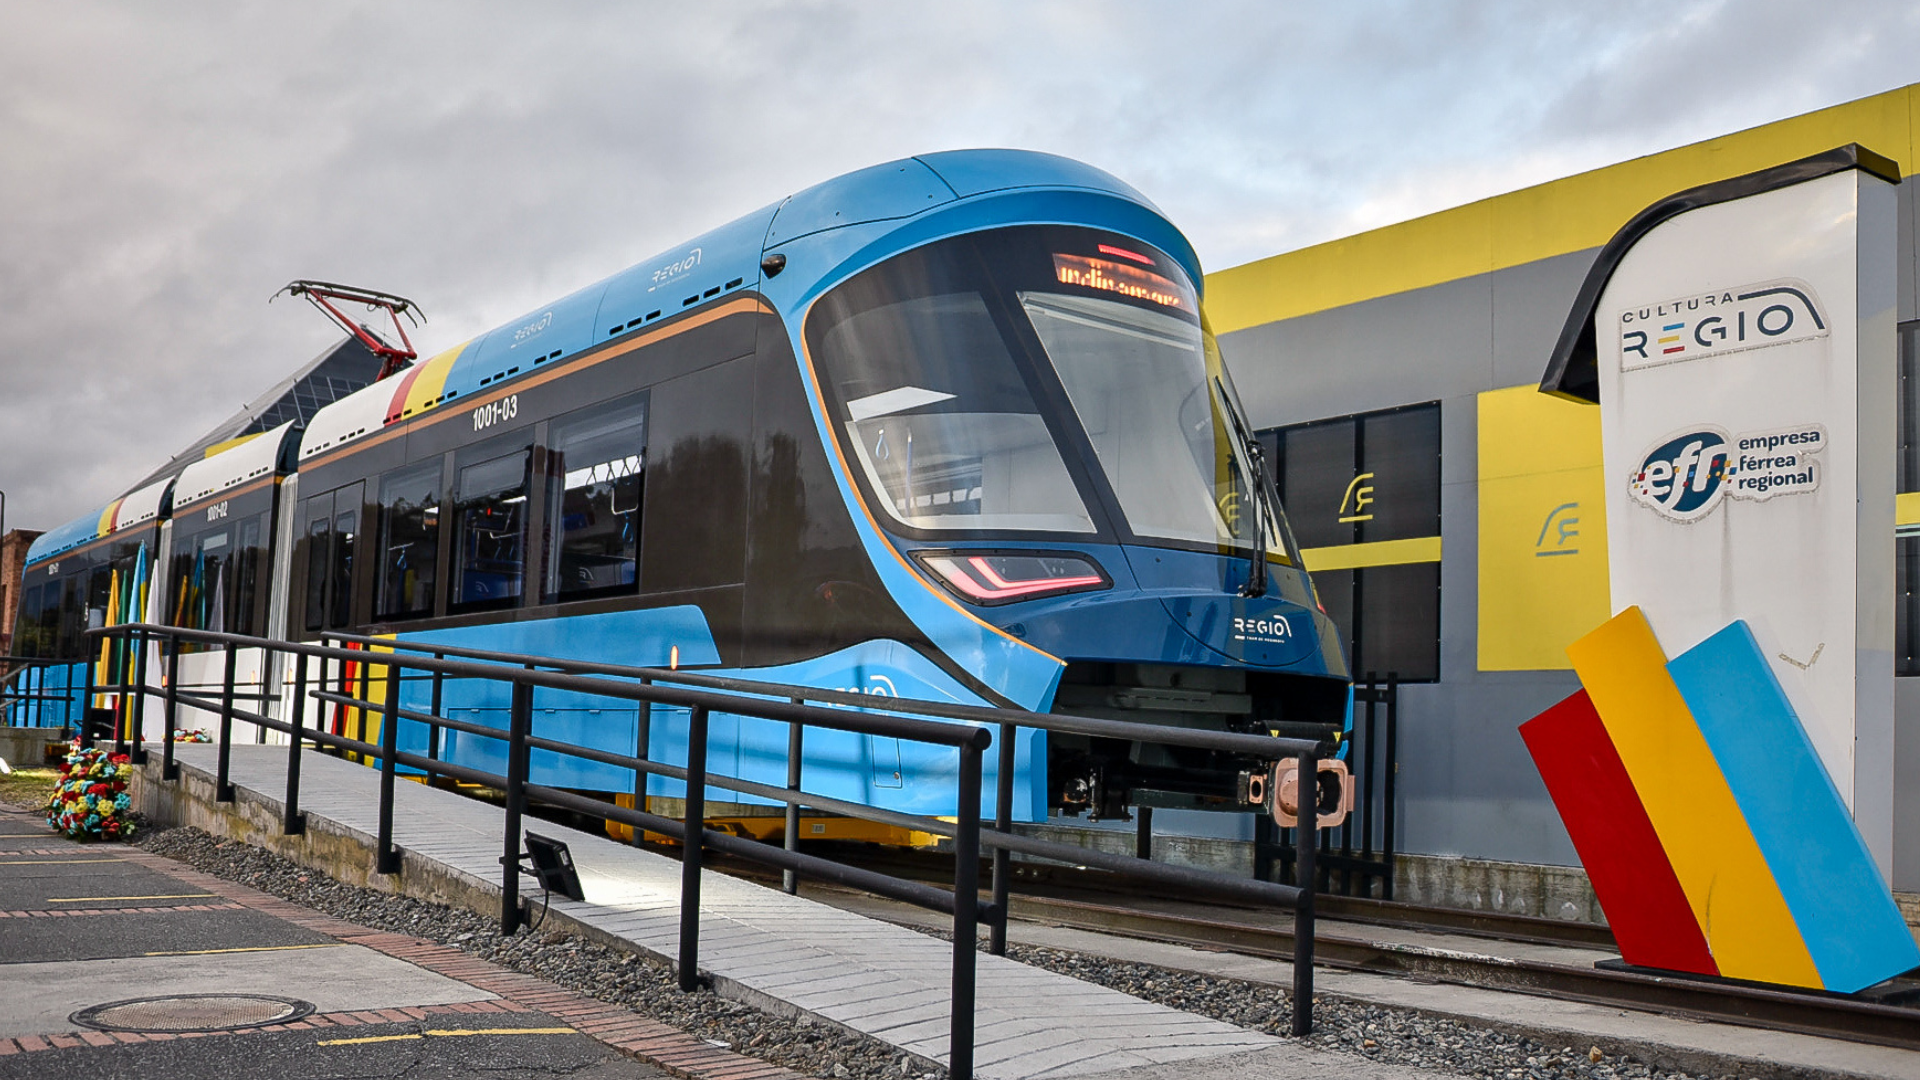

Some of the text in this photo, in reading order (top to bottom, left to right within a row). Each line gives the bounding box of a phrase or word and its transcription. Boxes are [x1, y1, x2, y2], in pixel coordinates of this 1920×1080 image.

[1622, 292, 1733, 323] CULTURA
[1623, 304, 1794, 358] REGIO
[473, 394, 518, 432] 1001-03
[1739, 431, 1820, 451] empresa
[1739, 454, 1796, 472] férrea
[1738, 466, 1814, 492] regional
[1234, 618, 1284, 636] REGIO
